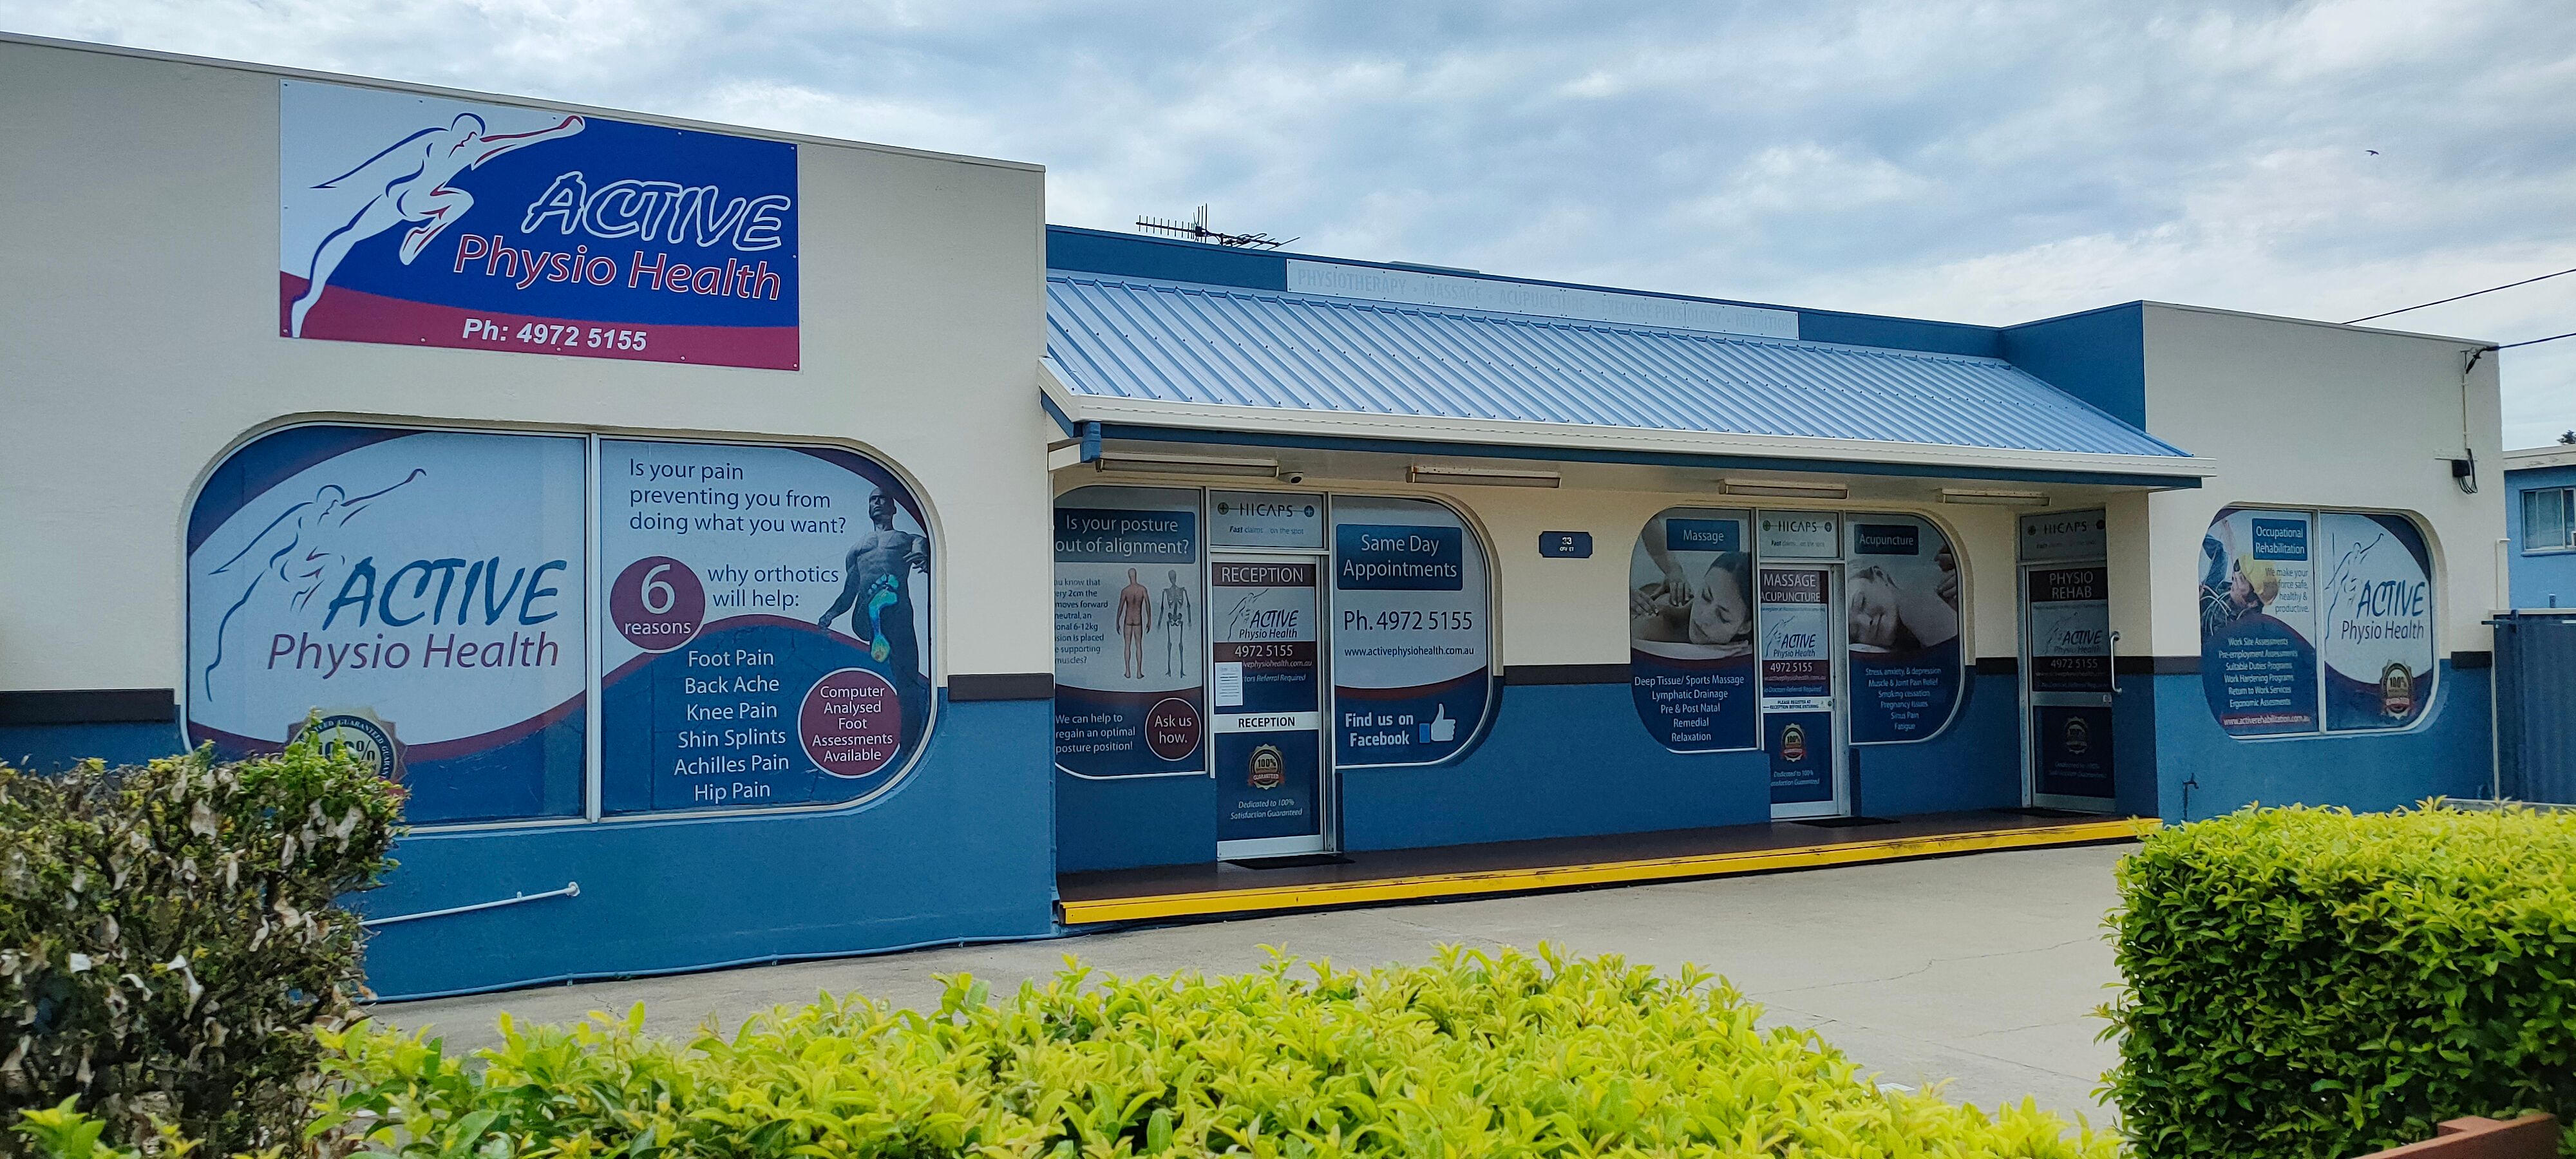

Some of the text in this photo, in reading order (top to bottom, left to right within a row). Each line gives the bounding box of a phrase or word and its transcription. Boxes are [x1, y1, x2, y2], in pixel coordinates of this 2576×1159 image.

[521, 171, 791, 251] ACTIVE
[453, 234, 782, 301] Physio Health
[1297, 268, 1407, 295] PHYSIOTHERAPY
[1424, 281, 1481, 301] MASSAGE
[463, 319, 647, 352] Ph: 4972 5155
[630, 458, 743, 483] Is your pain
[630, 488, 831, 510] preventing you from
[1240, 502, 1293, 517] HICAPS
[630, 513, 847, 536] doing what you want?
[1066, 515, 1179, 534] Is your posture
[1779, 521, 1817, 532] HICAPS
[2044, 521, 2087, 534] HICAPS
[1683, 529, 1724, 544] Massage
[1859, 533, 1914, 546] Acupuncture
[2256, 525, 2304, 540] Occupational
[1056, 537, 1189, 557] out of alignment?
[1361, 534, 1439, 556] Same Day
[2256, 543, 2305, 554] Rehabilitation
[708, 565, 839, 587] why orthotics
[1222, 567, 1303, 582] RECEPTION
[1343, 559, 1457, 581] Appointments
[2049, 570, 2093, 585] PHYSIO
[2277, 568, 2293, 576] make
[1764, 574, 1816, 587] MASSAGE
[322, 556, 567, 630] ACTIVE
[640, 563, 675, 614] 6
[2052, 585, 2092, 599] REHAB
[713, 590, 800, 610] will help:
[1761, 592, 1821, 602] ACUPUNCTURE
[2280, 594, 2302, 602] healthy
[2356, 580, 2425, 618] ACTIVE
[1249, 610, 1299, 628] ACTIVE
[1344, 610, 1472, 630] Ph. 4972 5155
[625, 620, 692, 635] reasons
[1074, 623, 1098, 632] 6-12kg
[1239, 628, 1297, 640] Physio Health
[2342, 619, 2423, 644] Physio Health
[1081, 634, 1104, 643] placed
[1781, 634, 1816, 649] ACTIVE
[2061, 630, 2103, 646] ACTIVE
[267, 630, 559, 680] Physio Health
[1061, 645, 1101, 654] supporting
[1235, 645, 1293, 657] 4972 5155
[1344, 645, 1474, 658] www.activephysiohealth.com.au
[1774, 649, 1794, 658] Physio
[688, 649, 774, 667] Foot Pain
[2050, 659, 2098, 668] 4972 5155
[1770, 662, 1812, 672] 4972 5155
[685, 675, 779, 694] Back Ache
[1634, 675, 1745, 688] Deep Sports Massage
[820, 685, 886, 702] Computer
[1652, 690, 1728, 702] Lymphatic Drainage
[1878, 690, 1903, 699] Smoking
[687, 702, 778, 721] Knee Pain
[824, 701, 882, 717] Analysed
[1661, 703, 1720, 714] Pre & Post Natal
[1880, 701, 1910, 710] Pregnancy
[838, 717, 867, 730] Foot
[1056, 713, 1122, 724] We can help to
[1155, 715, 1191, 728] Ask us
[1238, 717, 1295, 728] RECEPTION
[1345, 713, 1414, 727] Find us on
[1673, 717, 1709, 728] Remedial
[1056, 726, 1135, 740] regain an optimal
[1895, 722, 1915, 731] Fatigue
[678, 728, 786, 750] Shin Splints
[812, 732, 893, 748] Assessments
[1159, 731, 1188, 744] how.
[1350, 731, 1410, 747] Facebook
[1672, 732, 1711, 742] Relaxation
[824, 748, 882, 762] Available
[1056, 743, 1091, 754] posture
[674, 754, 790, 775] Achilles Pain
[694, 782, 771, 804] Hip Pain
[1238, 800, 1269, 809] Dedicated
[1231, 808, 1302, 820] Satisfaction Guaranteed
